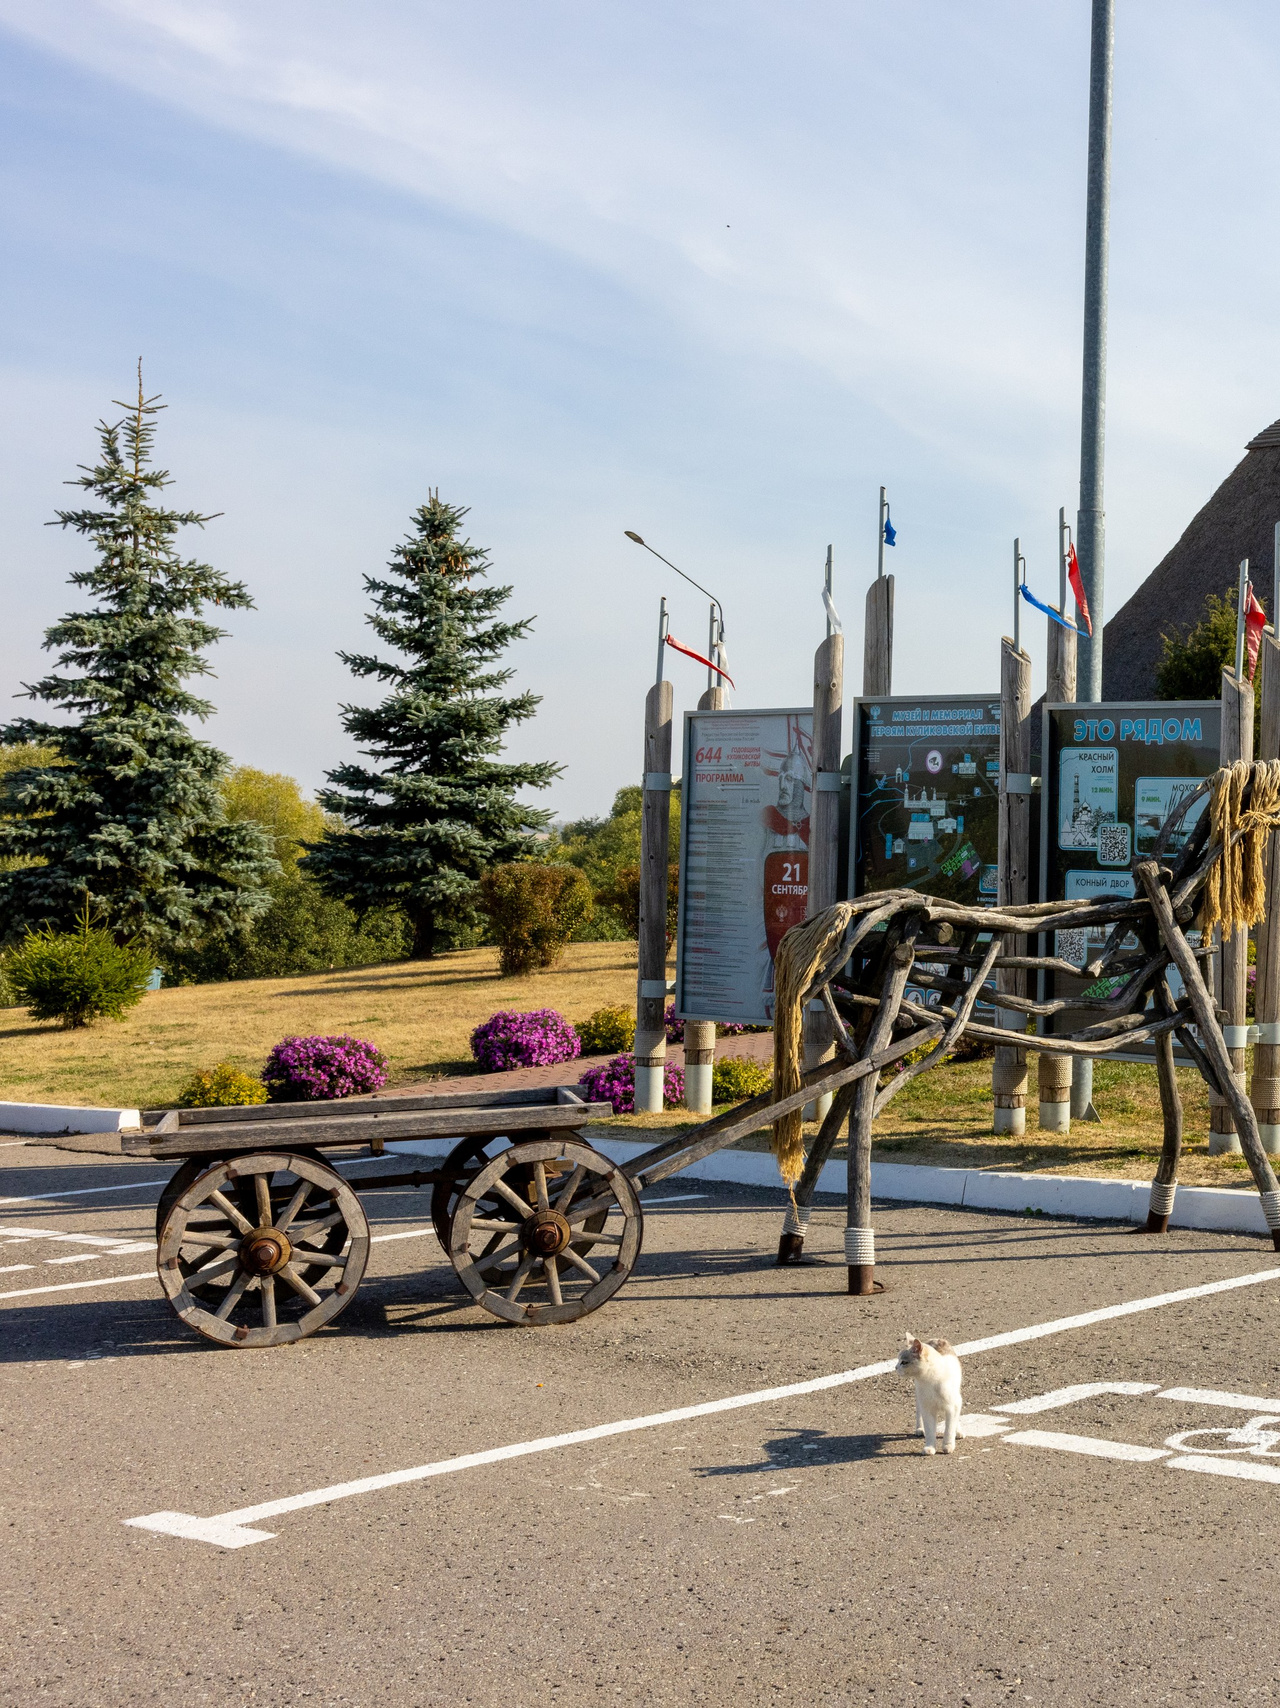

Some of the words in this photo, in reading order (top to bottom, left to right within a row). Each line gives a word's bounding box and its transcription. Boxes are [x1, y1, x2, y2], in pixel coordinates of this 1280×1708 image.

[892, 708, 921, 721] МУЗЕЙ
[922, 710, 930, 721] И
[931, 708, 983, 720] МЕМОРИАЛ
[871, 726, 905, 737] ГЕРОЯМ
[906, 722, 972, 736] КУЛИКОВСКОЙ
[1073, 718, 1115, 742] ЭТО
[1120, 718, 1202, 745] РЯДОМ
[695, 746, 722, 763] 644
[1079, 751, 1114, 761] КРАСНЫЙ
[696, 773, 744, 782] ПРОГРАММА
[782, 863, 800, 882] 21
[1075, 877, 1107, 887] КОННЫЙ
[1110, 880, 1130, 888] ДВОР
[772, 884, 808, 895] СЕНТЯБР
